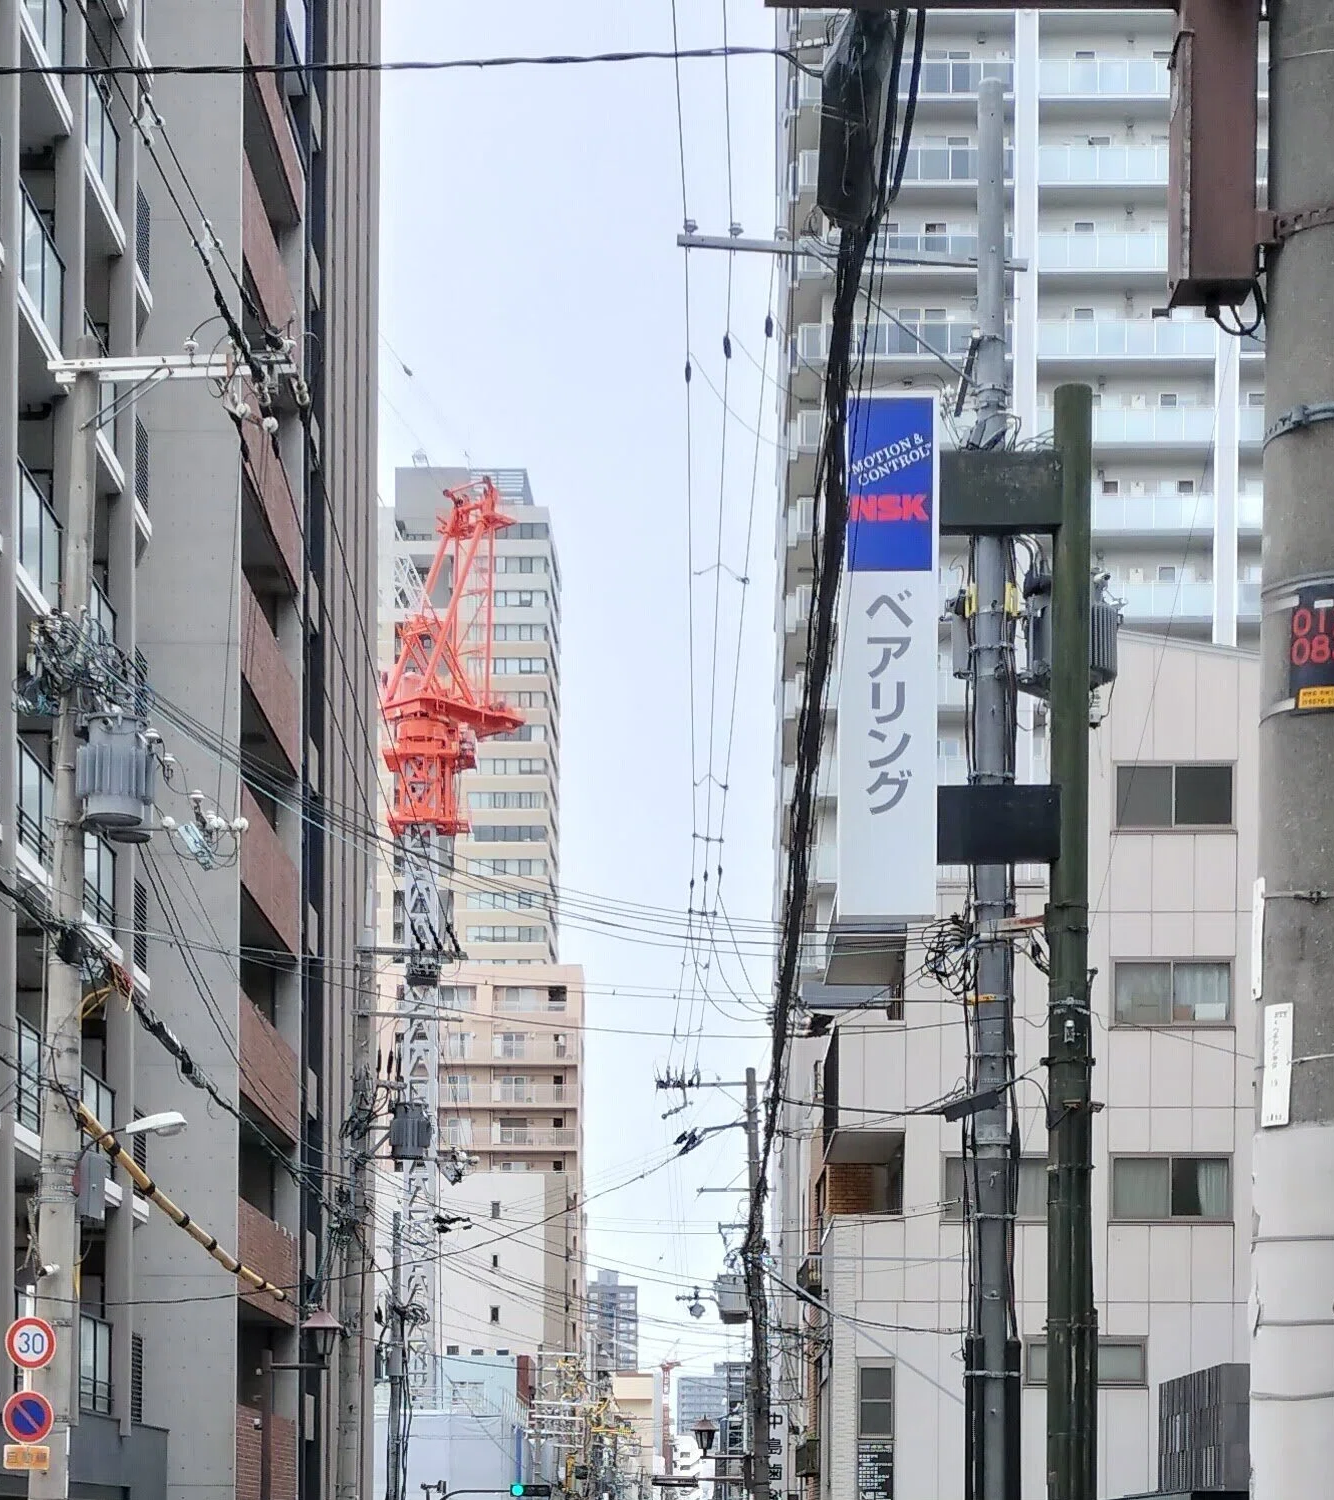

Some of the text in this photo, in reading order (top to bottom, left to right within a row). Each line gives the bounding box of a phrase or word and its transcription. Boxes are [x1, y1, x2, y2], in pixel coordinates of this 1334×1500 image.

[851, 432, 924, 475] MOTION &
[850, 494, 929, 522] NSK
[865, 588, 914, 816] ベアリング
[18, 1332, 45, 1355] 30
